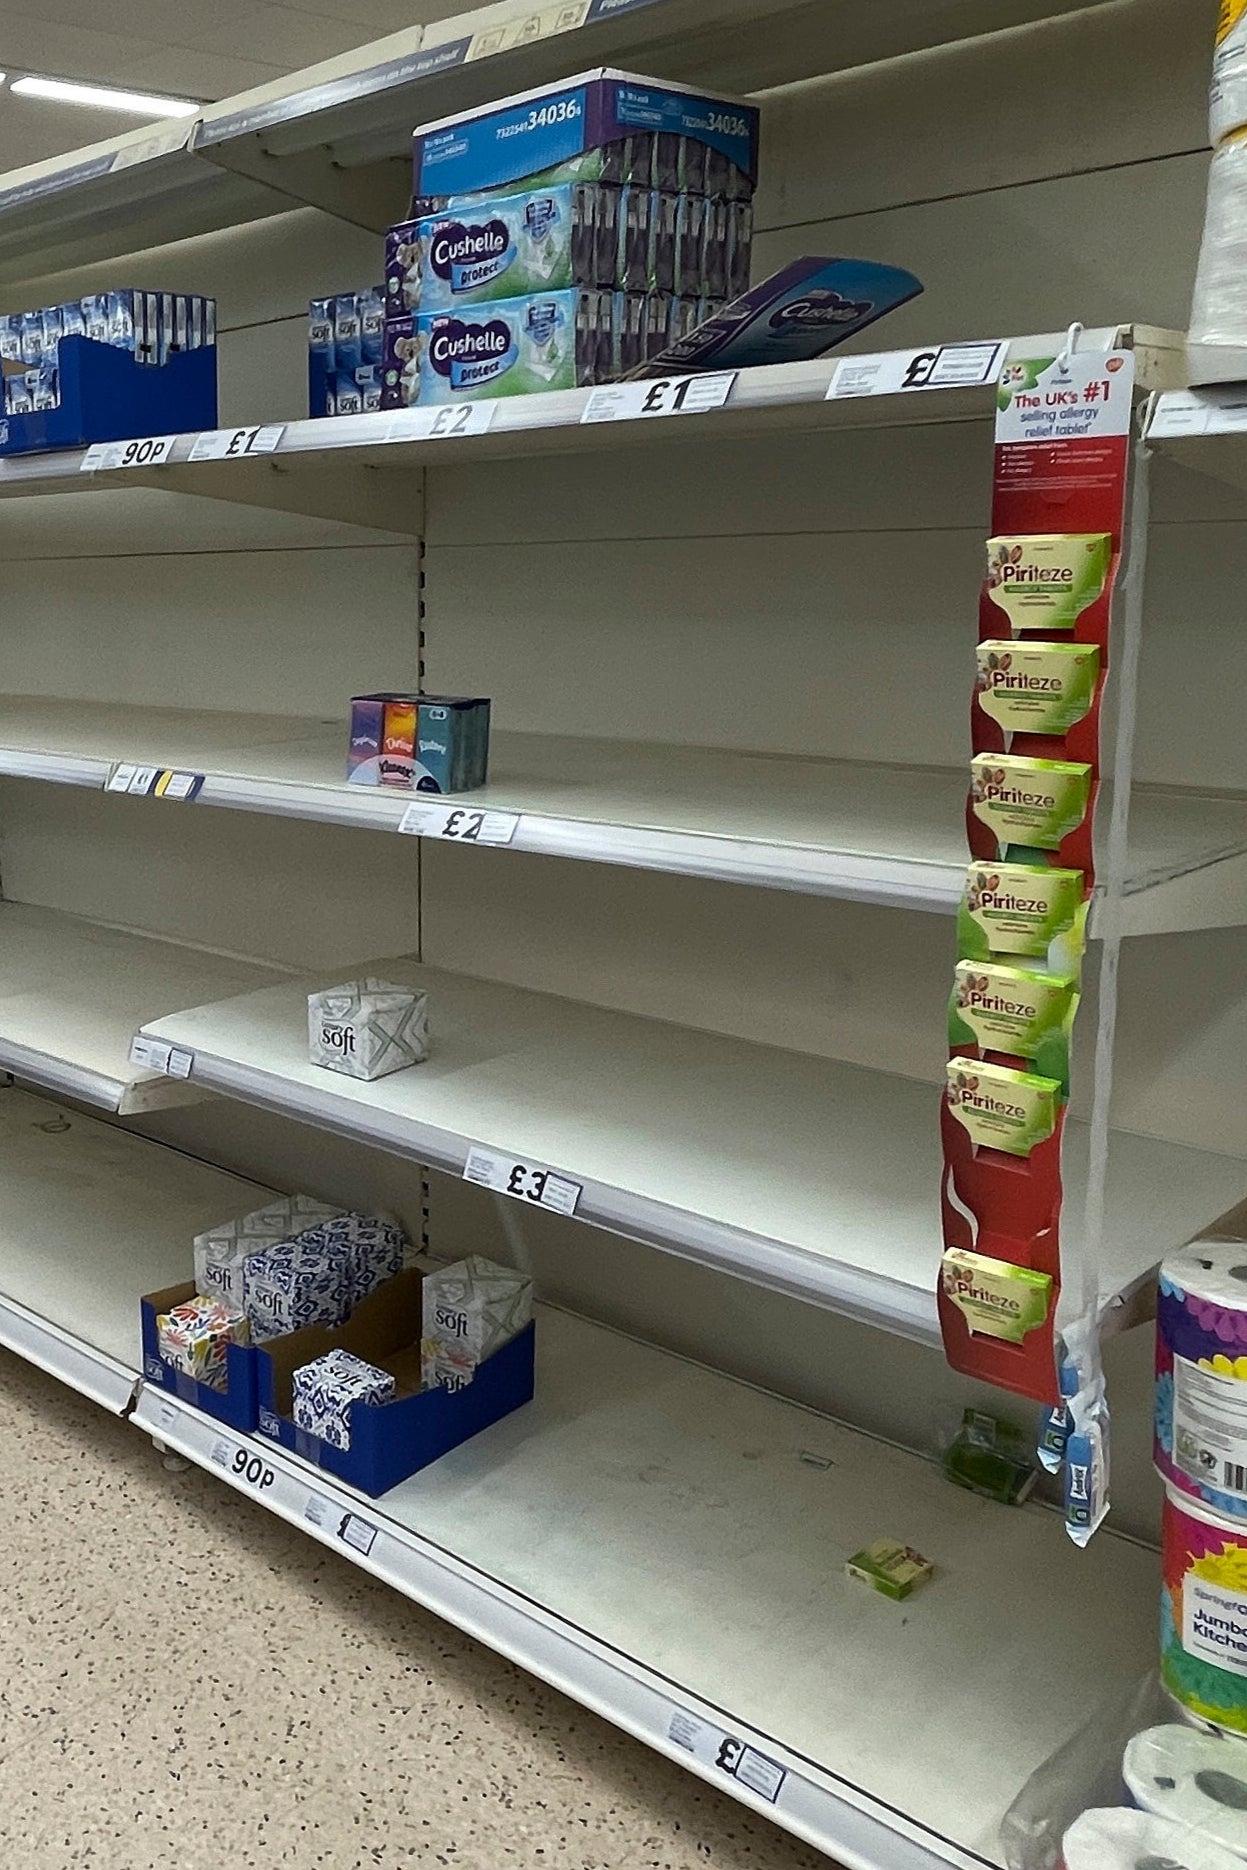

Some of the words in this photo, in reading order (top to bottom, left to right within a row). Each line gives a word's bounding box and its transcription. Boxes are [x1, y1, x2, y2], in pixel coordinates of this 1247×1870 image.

[435, 231, 504, 265] Cushelle
[460, 262, 499, 286] protect
[434, 331, 506, 361] Cushelle
[460, 361, 500, 383] protect
[1014, 394, 1041, 409] The
[1046, 391, 1079, 406] UK's
[1083, 380, 1111, 403] #1
[429, 404, 474, 435] £2
[1020, 409, 1057, 424] selling
[1059, 406, 1099, 421] allergy
[1025, 425, 1053, 438] relief
[1003, 564, 1073, 582] Piriteze
[993, 671, 1063, 691] Piriteze
[987, 785, 1056, 807] Piriteze
[981, 891, 1048, 914] Piriteze
[970, 991, 1036, 1018] Piriteze
[322, 1026, 357, 1056] soft
[962, 1090, 1027, 1120] Piriteze
[507, 1164, 548, 1201] £3
[206, 1267, 233, 1292] soft
[255, 1290, 284, 1317] soft
[958, 1281, 1020, 1312] Piriteze
[435, 1309, 469, 1338] soft
